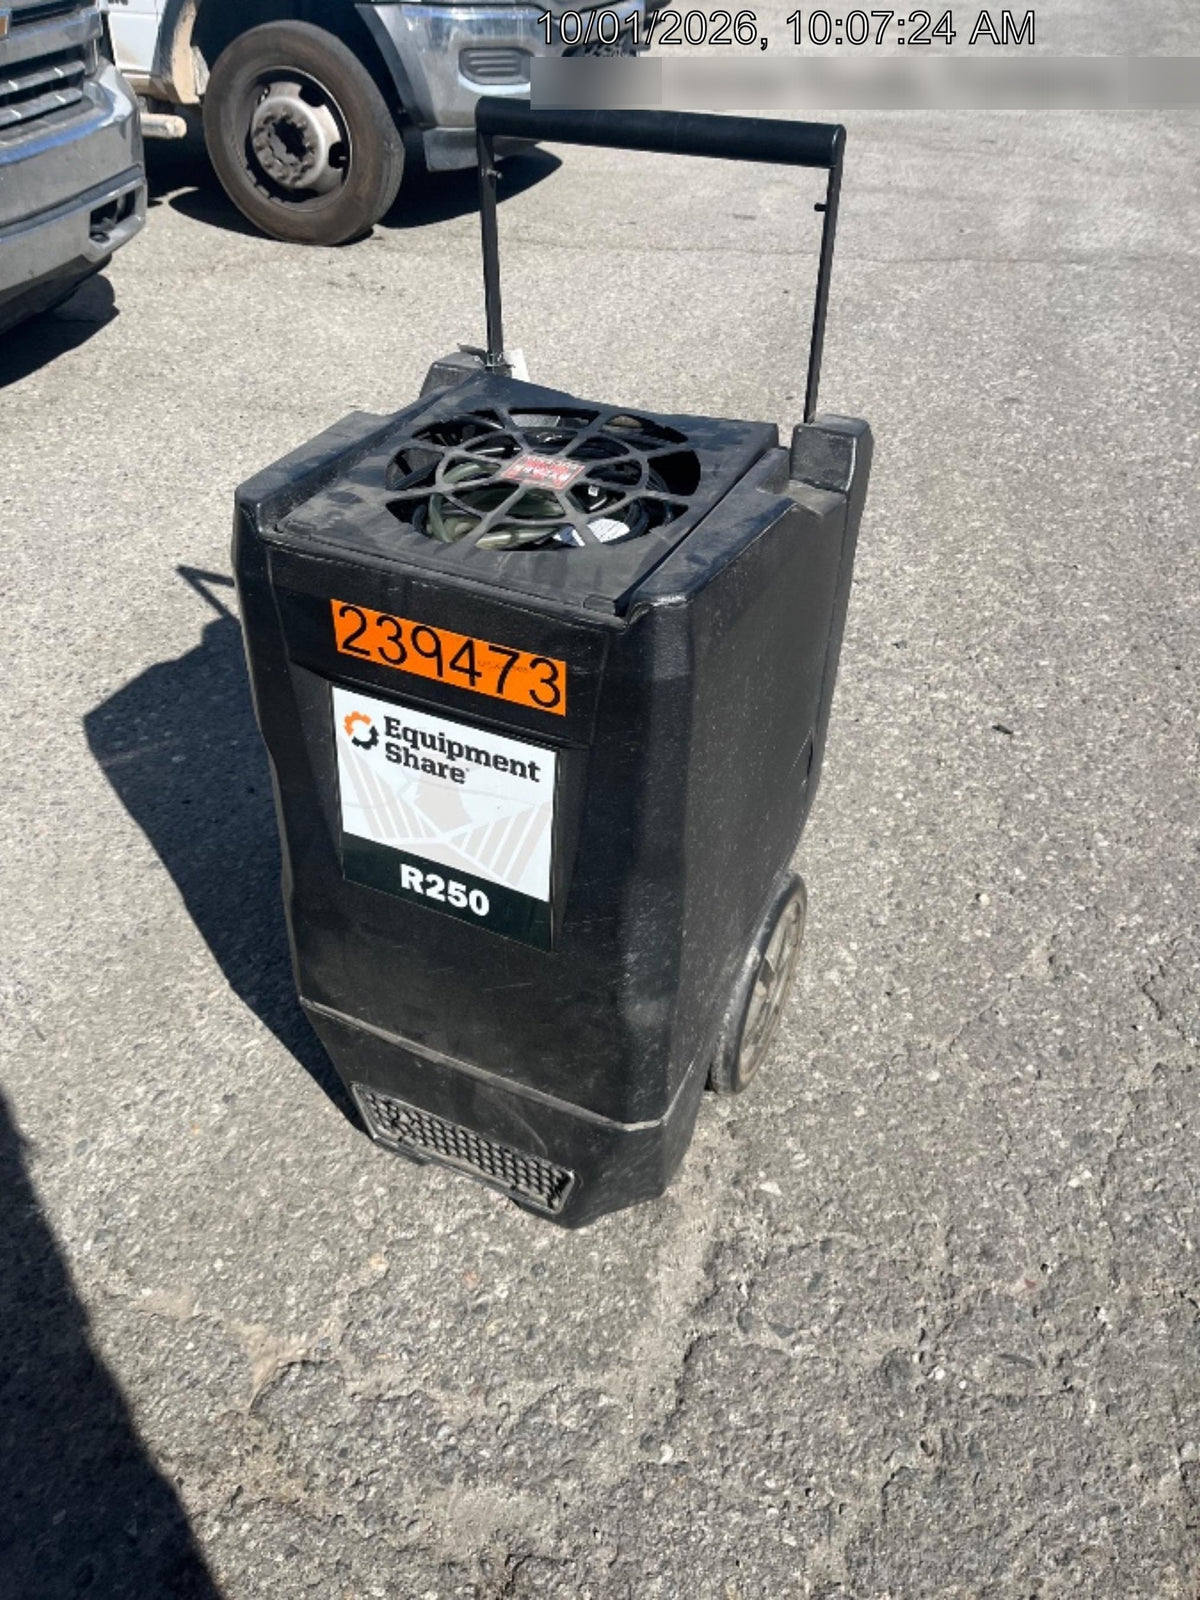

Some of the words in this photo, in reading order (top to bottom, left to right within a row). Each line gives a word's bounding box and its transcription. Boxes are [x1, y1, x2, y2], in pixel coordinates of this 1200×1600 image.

[338, 605, 561, 708] 239473
[384, 716, 541, 782] Equipment
[385, 742, 466, 784] Share
[400, 863, 490, 916] R250
